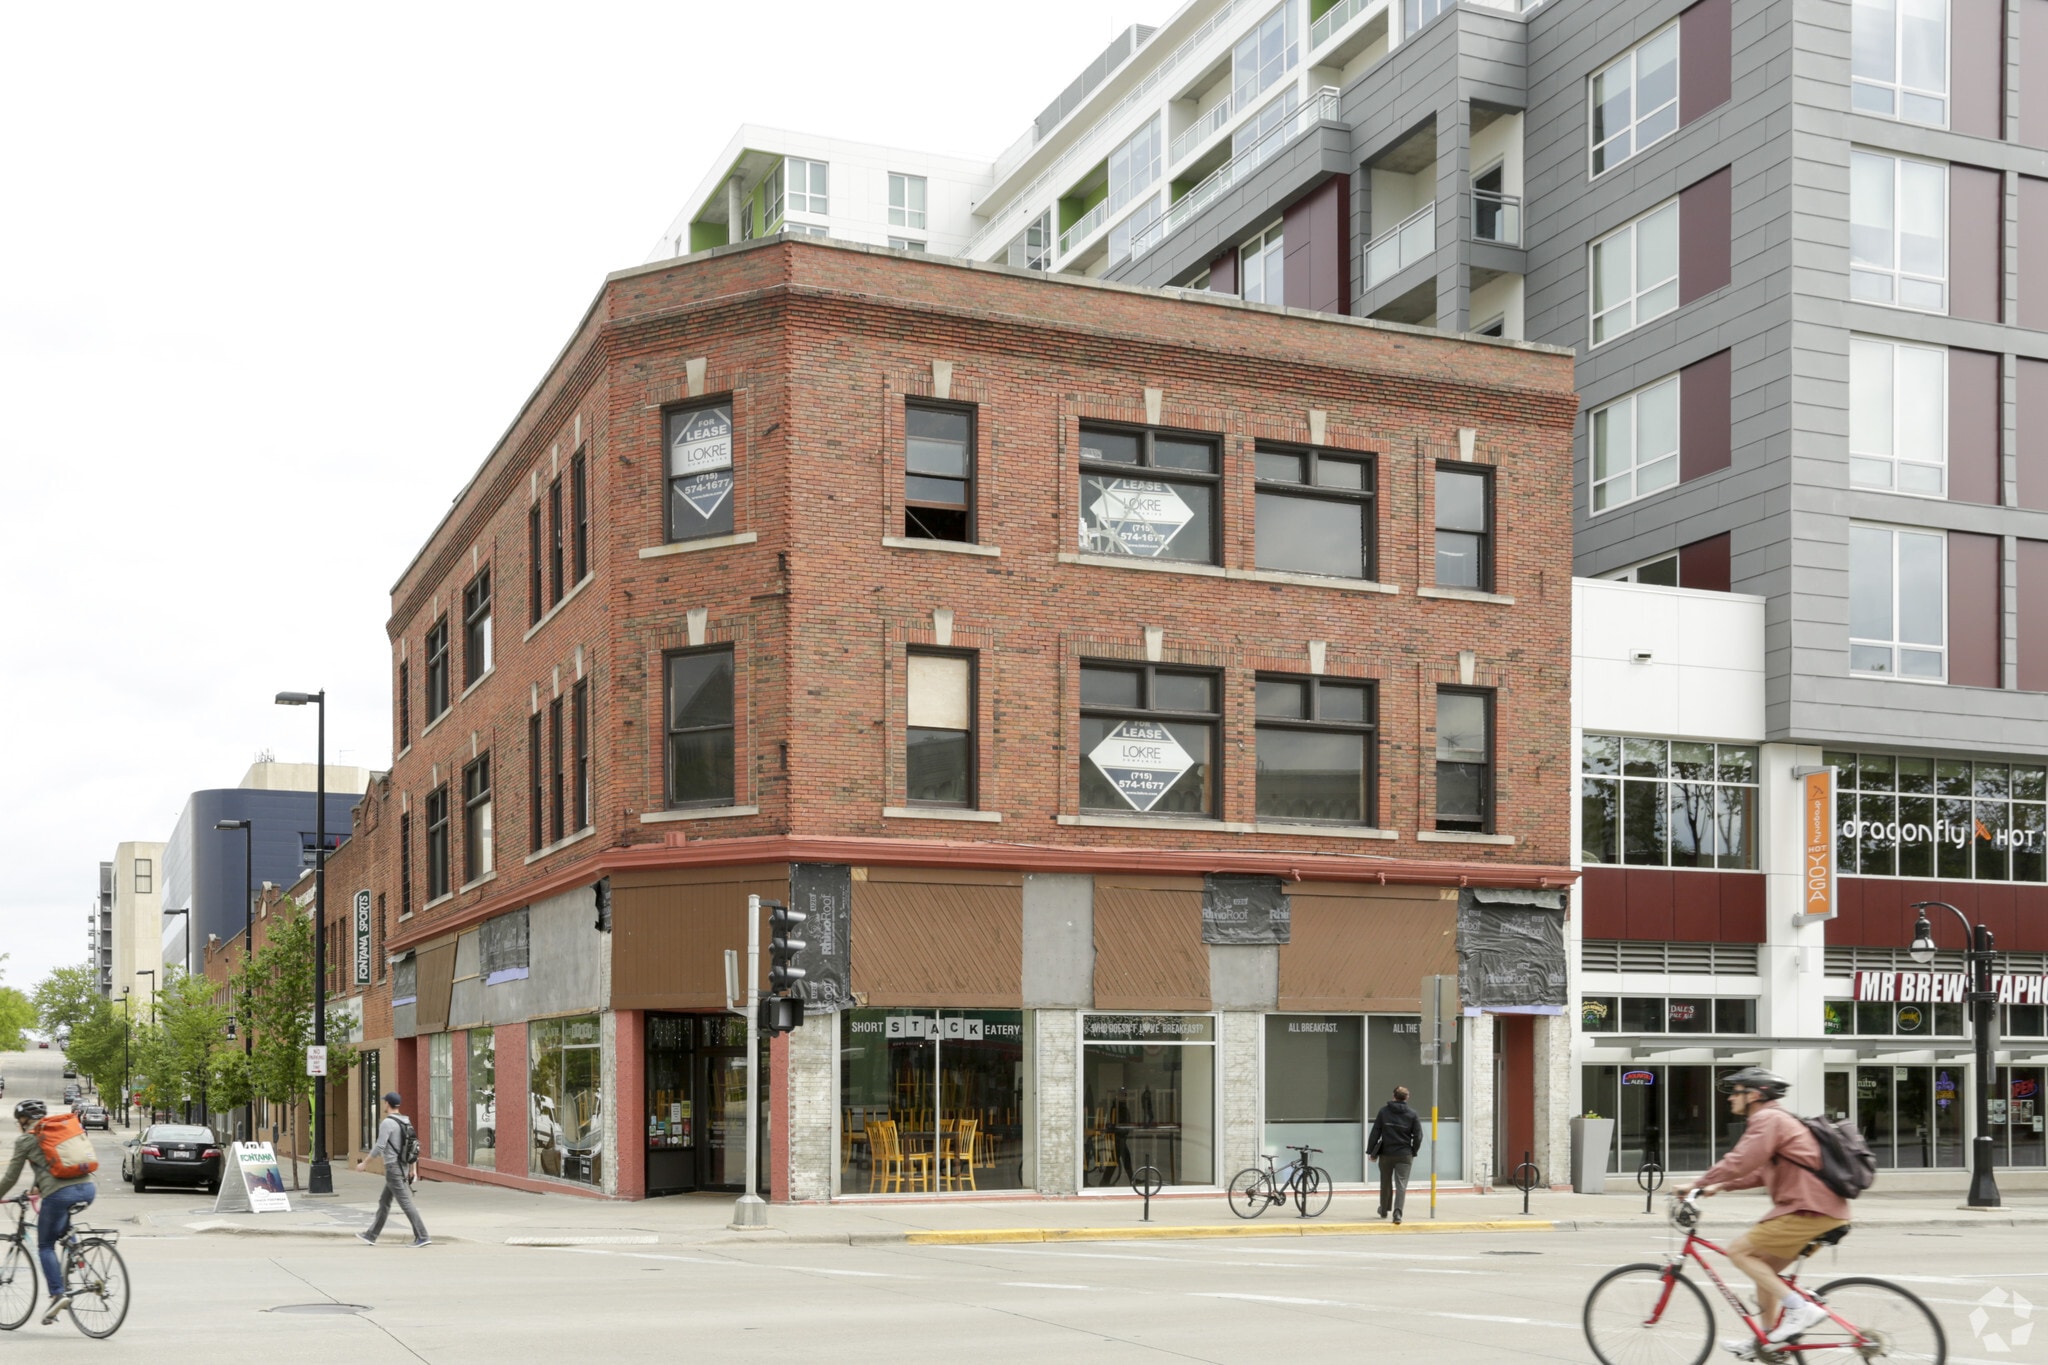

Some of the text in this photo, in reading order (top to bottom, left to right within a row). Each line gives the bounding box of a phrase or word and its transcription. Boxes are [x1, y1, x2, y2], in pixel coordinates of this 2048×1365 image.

[698, 418, 715, 428] FOR
[686, 424, 727, 441] LEASE
[687, 443, 727, 463] LOKRE
[696, 472, 718, 484] (715)
[684, 478, 730, 495] 574-1677
[1122, 479, 1162, 492] LEASE
[1123, 497, 1161, 512] LOKRE
[1132, 524, 1153, 533] (715)
[1122, 727, 1162, 739] LEASE
[1122, 745, 1161, 760] LOKRE
[1130, 772, 1152, 781] (715)
[1118, 780, 1164, 790] 574-1677
[1813, 800, 1822, 844] dragonfly
[1843, 814, 1966, 849] dragonfly
[1996, 828, 2035, 847] HOT
[1808, 844, 1828, 853] HOT
[1808, 853, 1827, 903] YOGA
[1202, 906, 1249, 920] RhinoRoof
[820, 893, 832, 955] RhinoRoof
[358, 895, 370, 980] FONTANA SPORTS
[1859, 972, 1896, 1001] MR
[1900, 973, 1972, 1003] BREW'
[851, 1020, 1021, 1036] SHORT STACK EATERY
[1162, 1023, 1204, 1034] BREAKFAST?
[1288, 1023, 1338, 1033] ALL BREAKFAST.
[1392, 1023, 1405, 1033] ALL
[1405, 1023, 1418, 1034] THE
[1857, 1077, 1877, 1088] nitro
[240, 1152, 275, 1162] FONTANA
